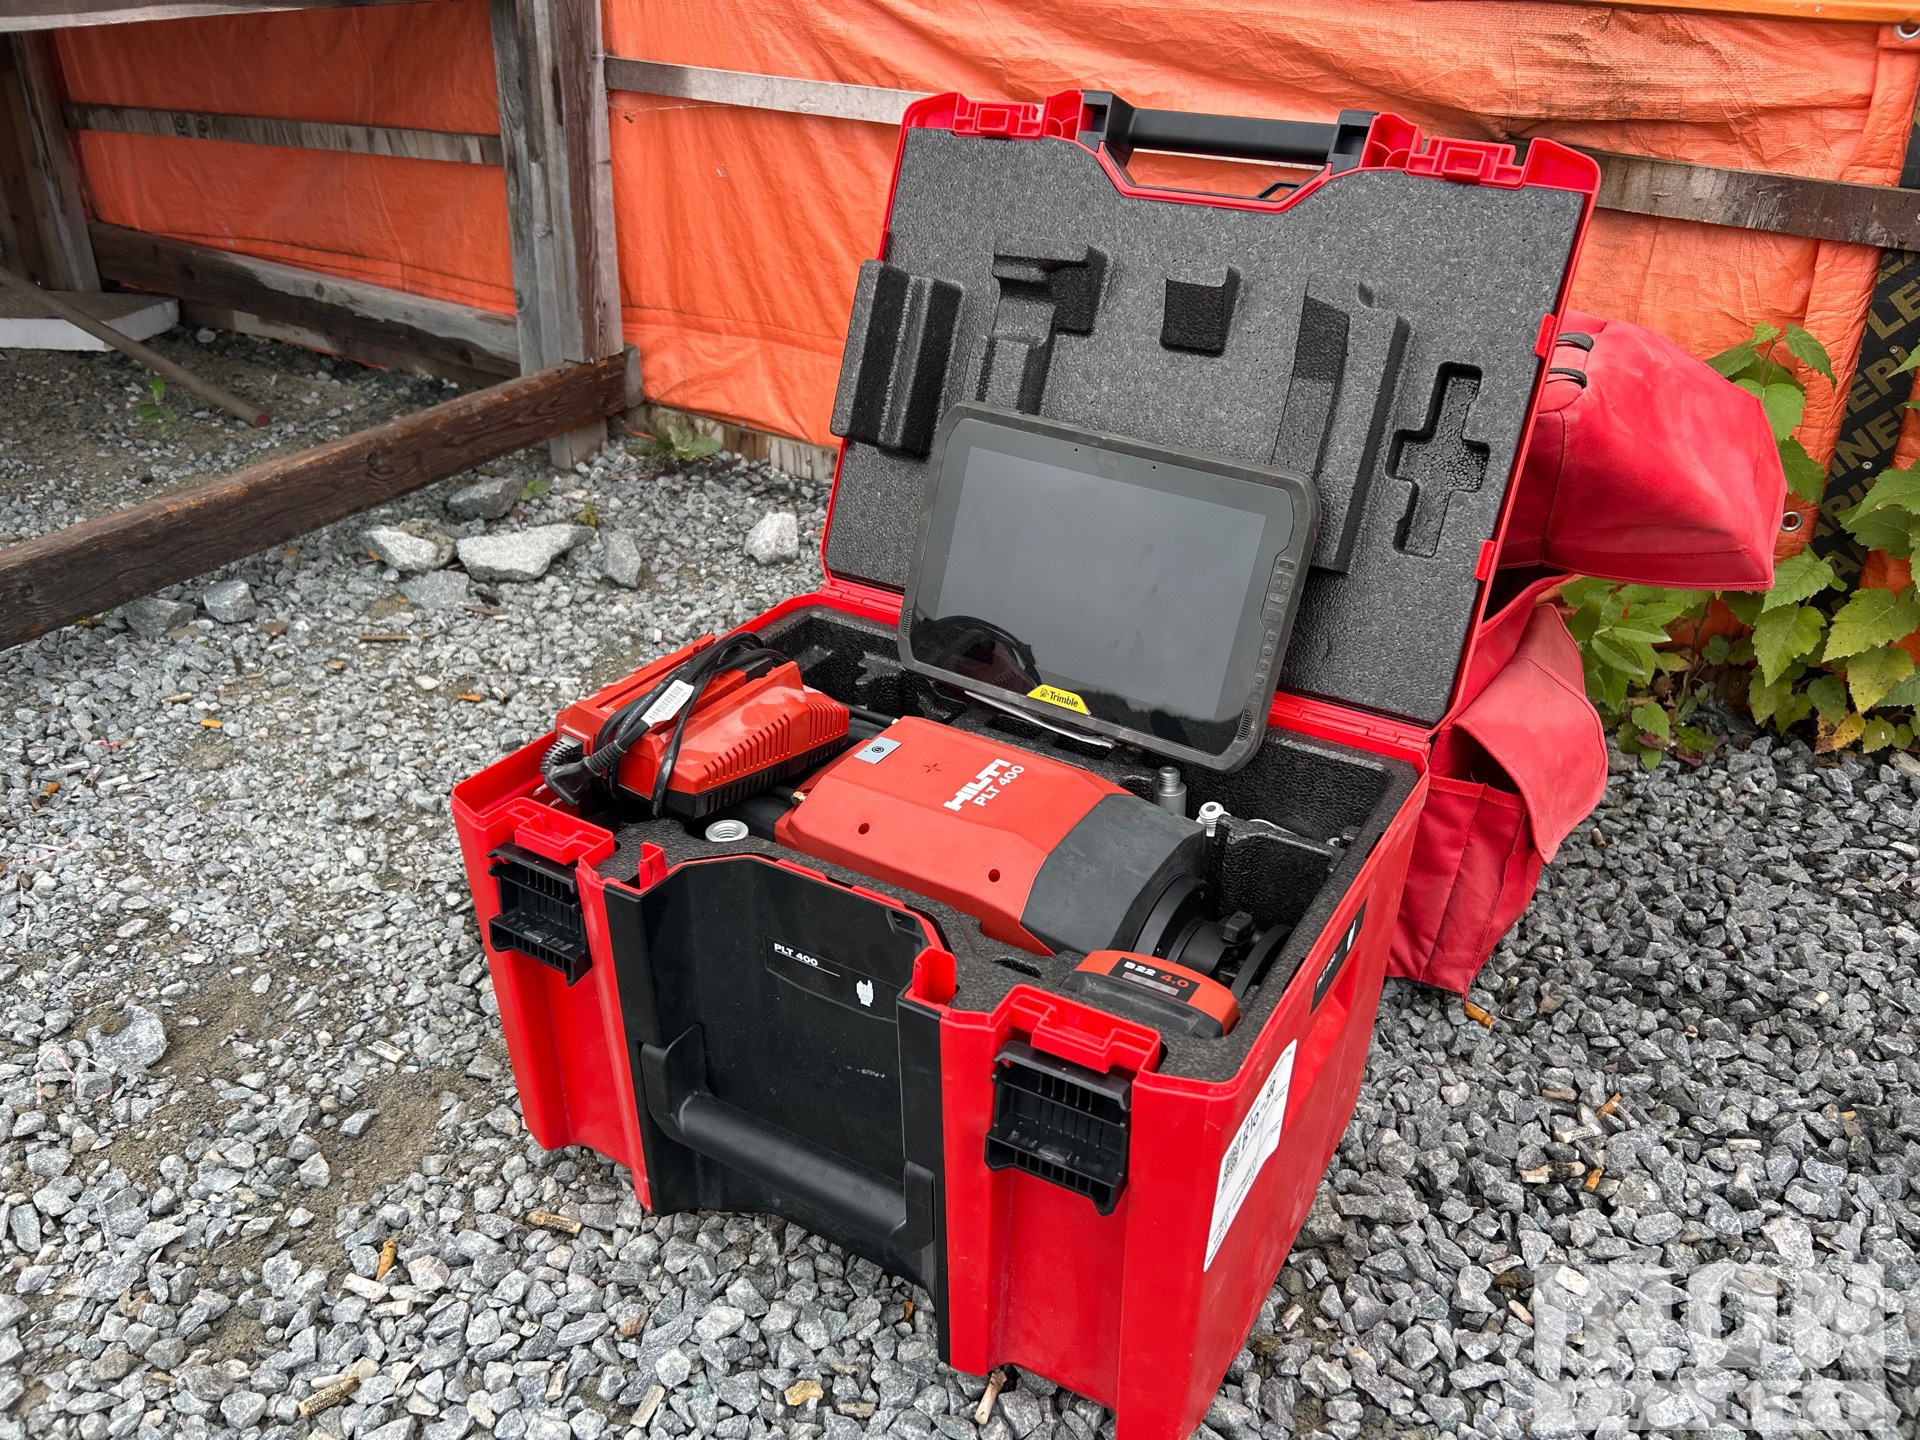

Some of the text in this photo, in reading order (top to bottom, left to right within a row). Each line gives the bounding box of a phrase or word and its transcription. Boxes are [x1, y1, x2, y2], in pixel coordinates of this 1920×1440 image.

[1049, 690, 1079, 708] Trimble
[943, 758, 1012, 811] HILTI
[972, 765, 1025, 807] PLT 400
[774, 942, 819, 967] PLT 400
[1123, 961, 1190, 988] B22 4.0
